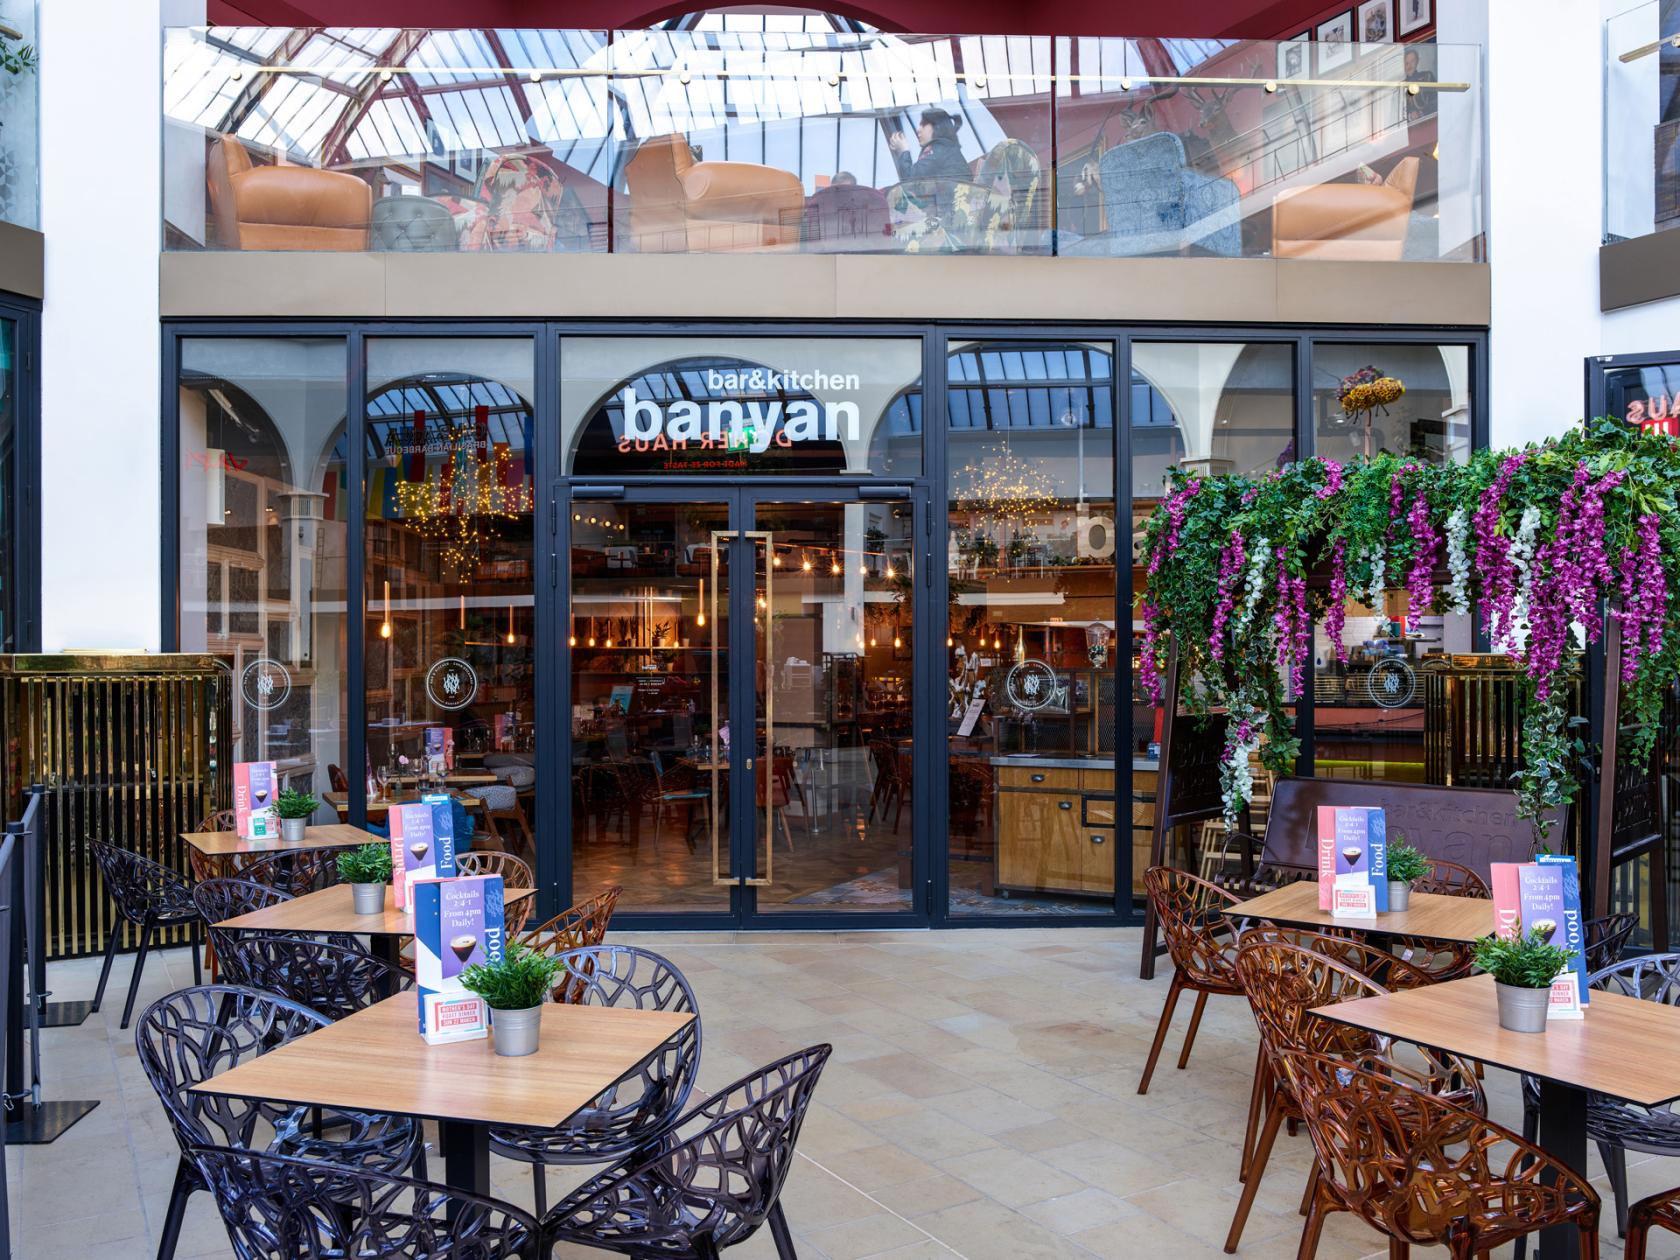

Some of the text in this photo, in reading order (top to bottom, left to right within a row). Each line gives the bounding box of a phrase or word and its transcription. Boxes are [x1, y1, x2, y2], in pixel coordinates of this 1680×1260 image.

[709, 369, 860, 391] bar&kitchen
[624, 388, 860, 453] banyan
[237, 785, 248, 814] Drink
[394, 837, 406, 875] Drink
[438, 837, 453, 869] Food
[1321, 839, 1335, 877] Drink
[1370, 843, 1384, 876] Food
[1524, 875, 1558, 884] Cocktails
[445, 889, 480, 900] Cocktails
[1532, 902, 1553, 912] Daily!
[443, 908, 481, 919] From 4pm
[451, 918, 475, 928] Daily!
[1498, 909, 1517, 938] Dri
[484, 927, 502, 962] ood
